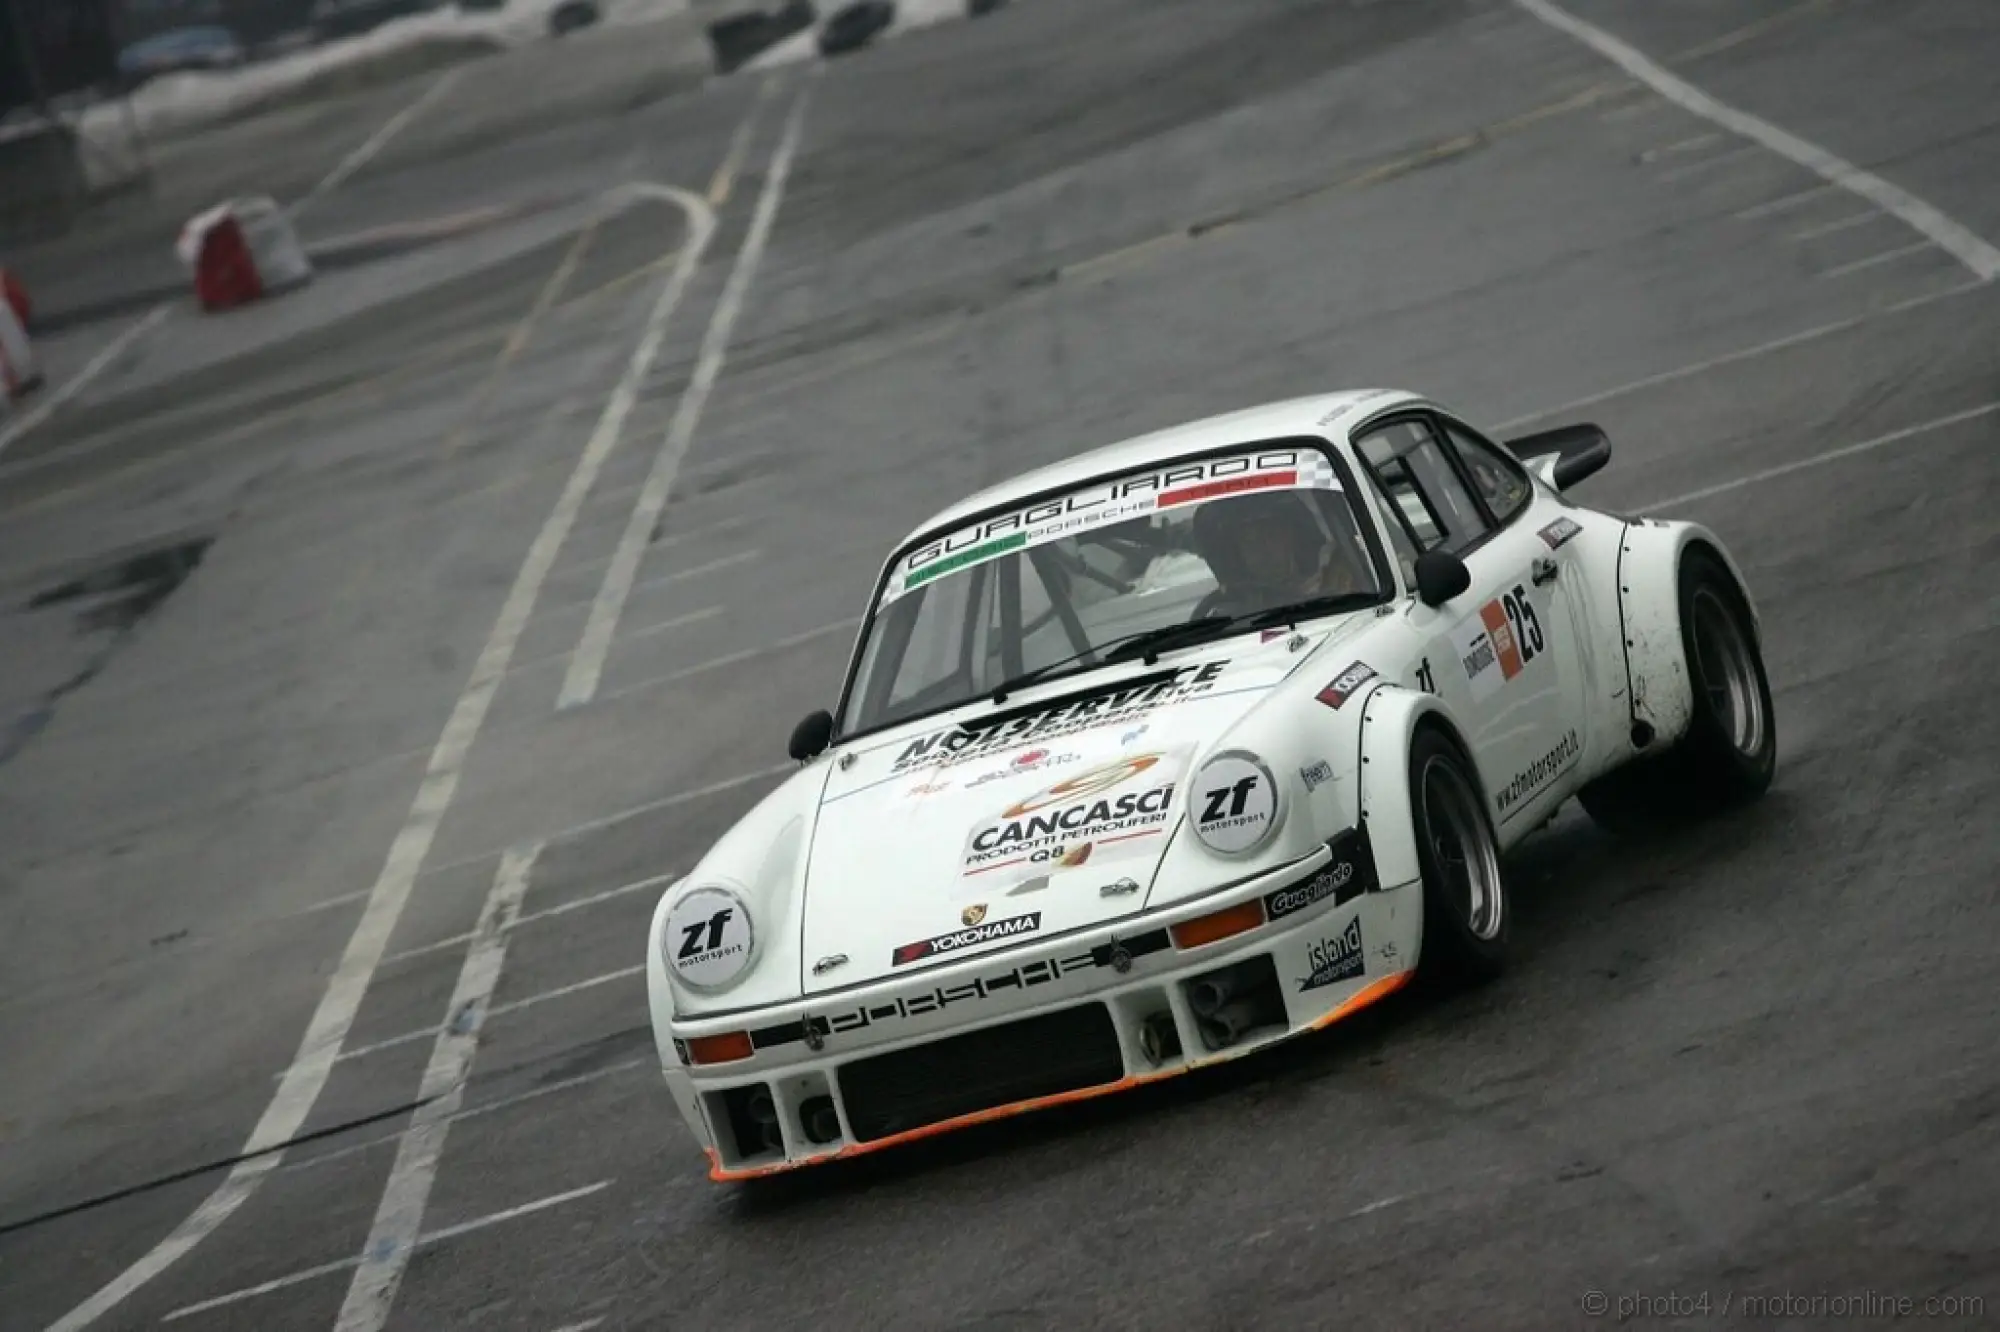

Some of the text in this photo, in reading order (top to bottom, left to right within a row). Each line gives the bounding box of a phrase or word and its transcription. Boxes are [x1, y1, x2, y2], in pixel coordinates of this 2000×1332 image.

[908, 453, 1297, 568] GUAGLIARDO
[1503, 583, 1543, 662] 25
[973, 784, 1174, 851] CANCASCI
[1200, 774, 1258, 824] zf
[966, 813, 1167, 865] PRODOTTI PETROLIFERI
[1030, 846, 1065, 863] Q8
[678, 908, 733, 960] zf
[679, 944, 743, 968] motorsport
[931, 915, 1036, 952] YOKOHAMA
[829, 951, 1098, 1035] PORSCHE
